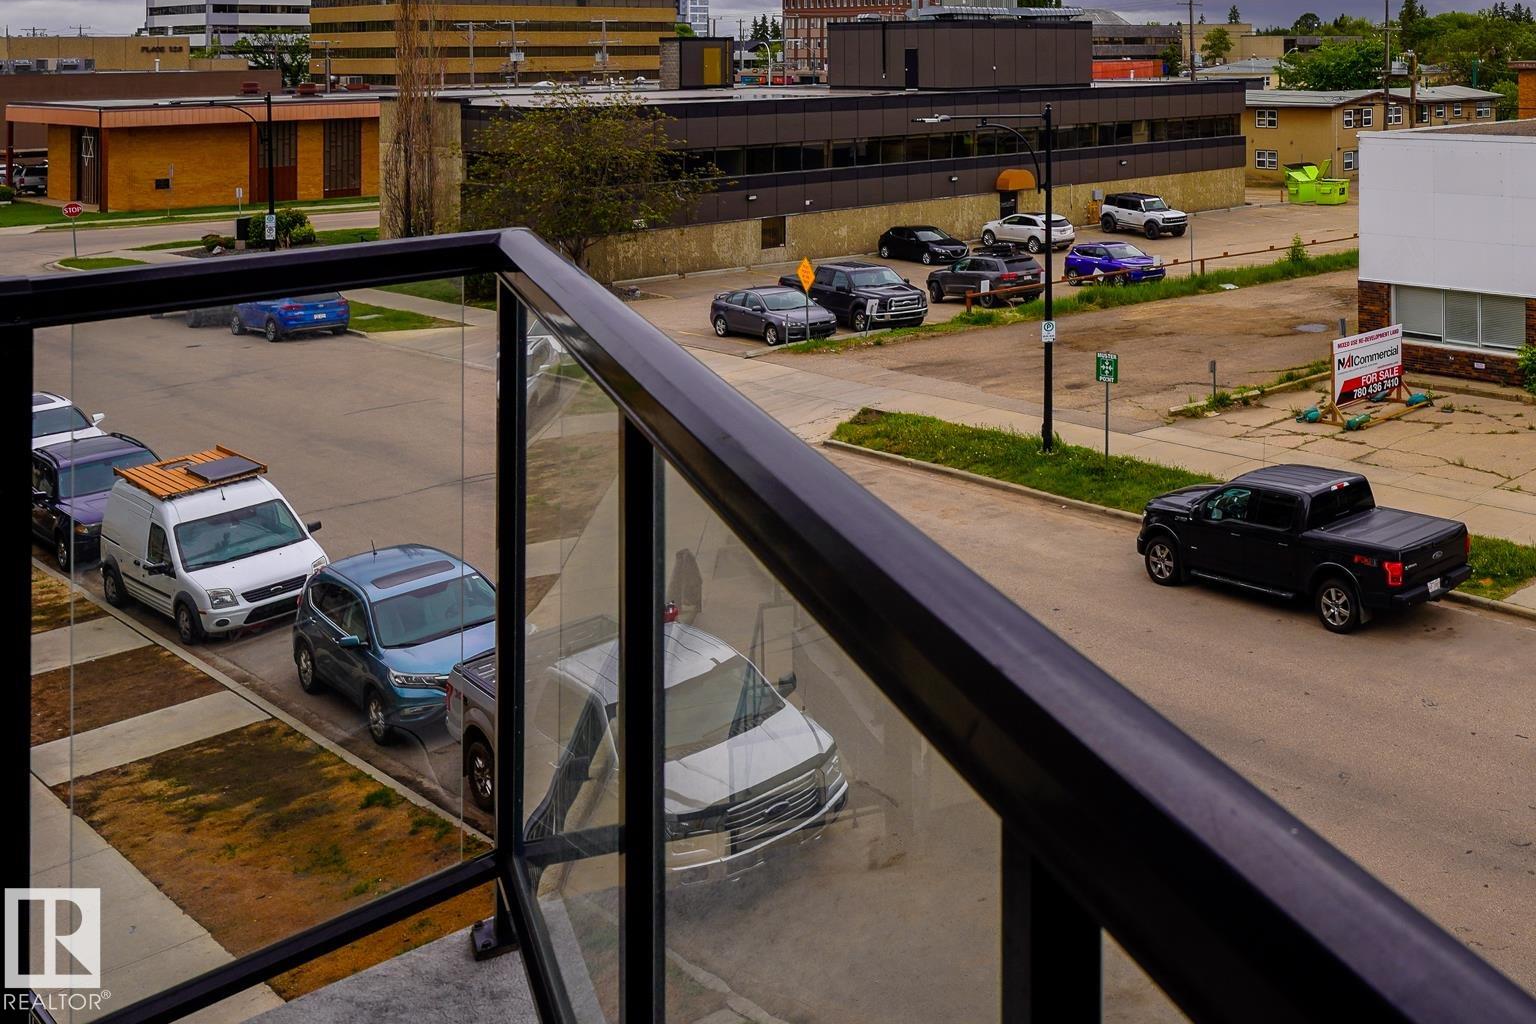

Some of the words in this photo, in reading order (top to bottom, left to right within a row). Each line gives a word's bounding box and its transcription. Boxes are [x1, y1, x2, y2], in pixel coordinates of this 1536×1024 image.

[64, 206, 82, 214] STOP
[1390, 328, 1399, 336] LAND
[1361, 372, 1377, 386] FOR
[1379, 366, 1399, 380] SALE
[1353, 386, 1367, 399] 780
[1368, 381, 1382, 394] 436
[1383, 377, 1399, 389] 7410
